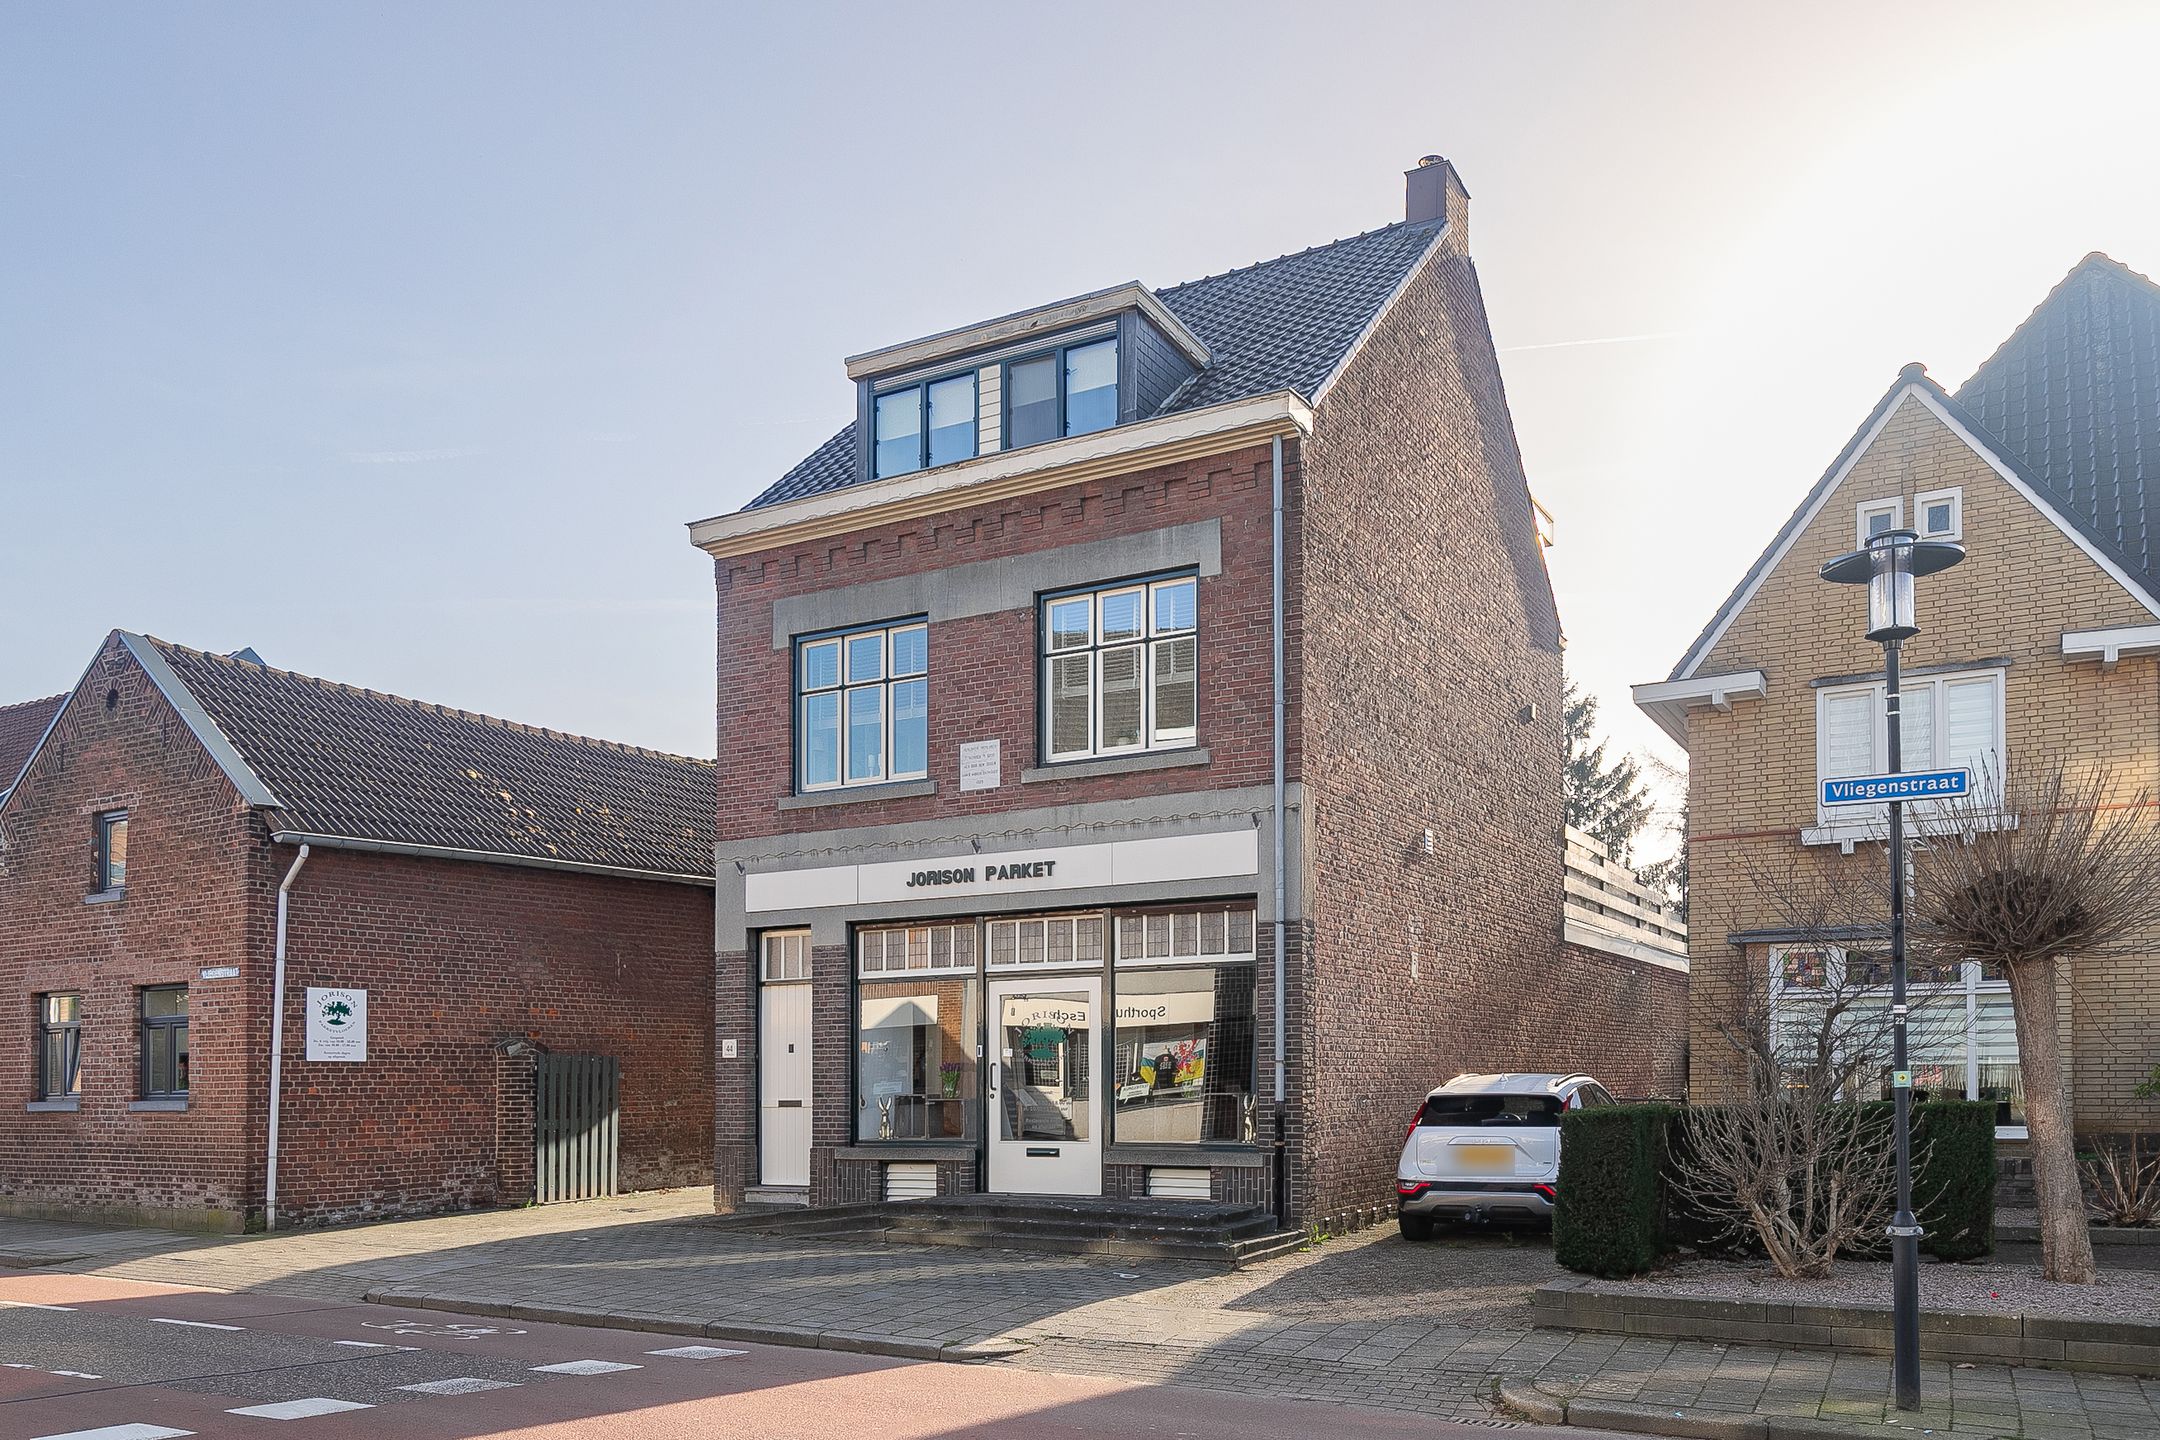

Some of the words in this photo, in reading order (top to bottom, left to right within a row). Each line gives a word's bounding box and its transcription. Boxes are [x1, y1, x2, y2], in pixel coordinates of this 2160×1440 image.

[1832, 776, 1959, 797] Vliegenstraat
[906, 867, 975, 887] JORISON
[985, 861, 1056, 881] PARKET
[316, 990, 358, 1008] JORISON
